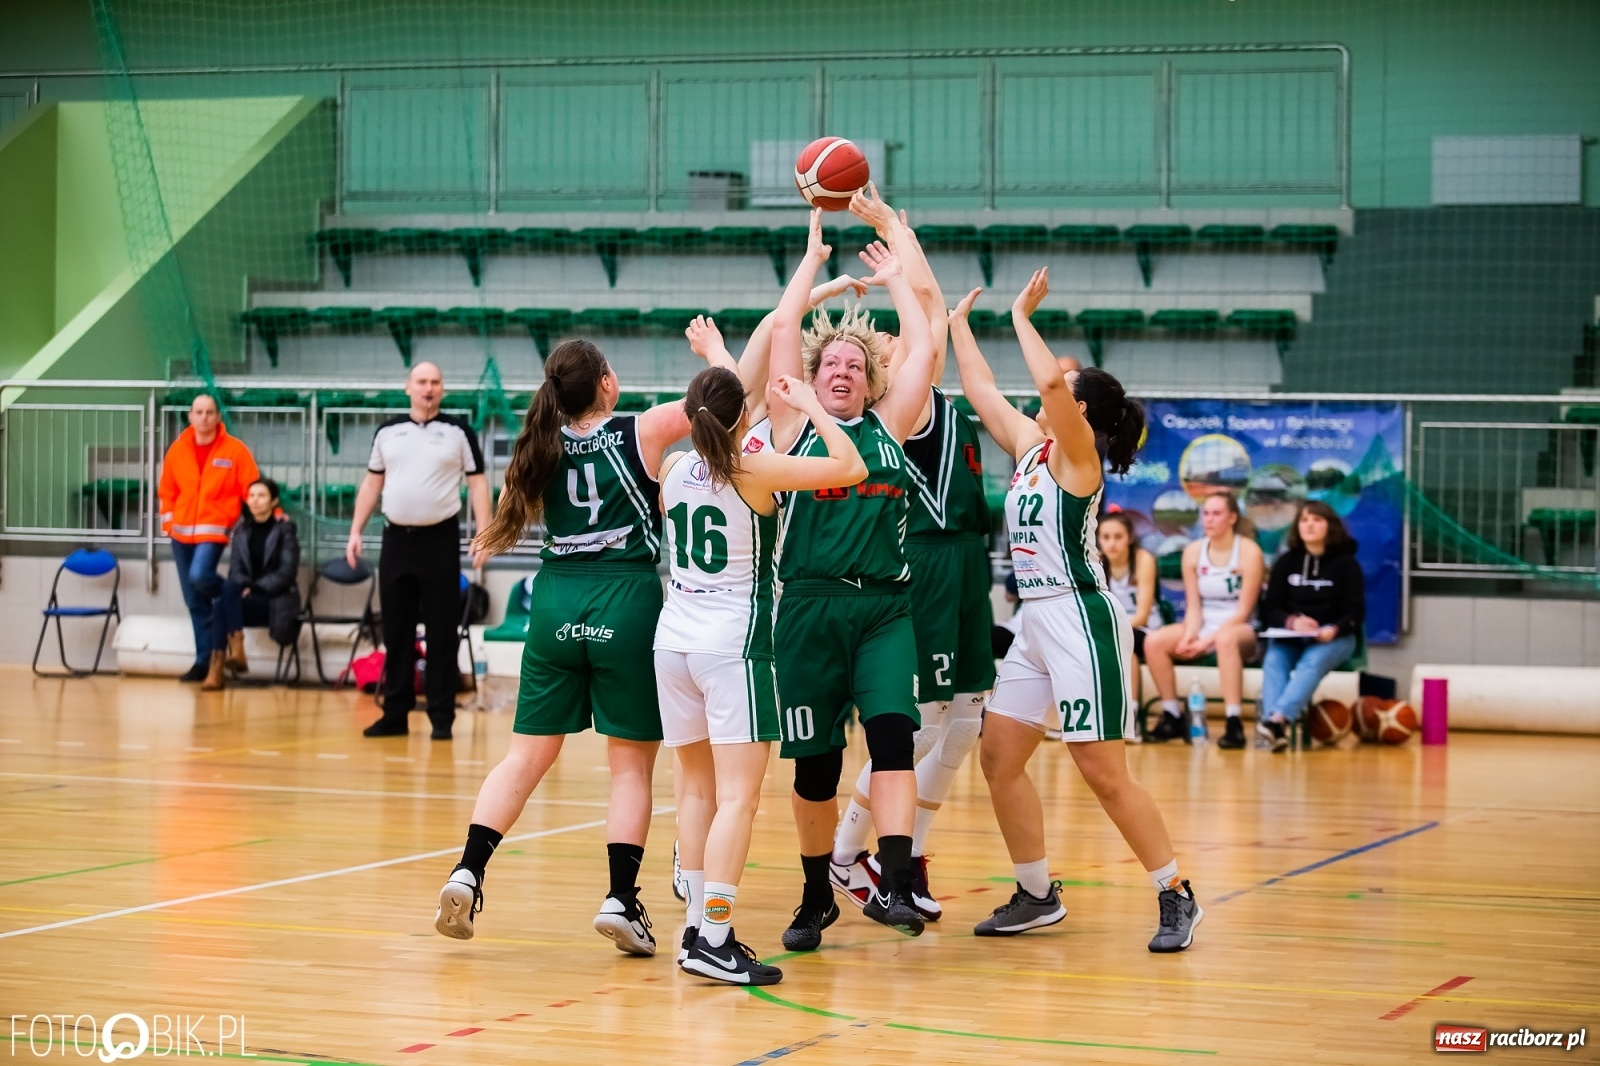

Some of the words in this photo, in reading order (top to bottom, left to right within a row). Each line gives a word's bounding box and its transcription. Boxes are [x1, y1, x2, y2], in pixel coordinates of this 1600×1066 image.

[564, 430, 624, 455] RACIBÓRZ
[878, 441, 900, 469] 10
[567, 463, 604, 526] 4
[1017, 493, 1044, 526] 22
[667, 501, 728, 574] 16
[572, 622, 614, 639] Clavis
[932, 652, 954, 686] 2
[786, 705, 815, 742] 10
[1060, 698, 1092, 732] 22
